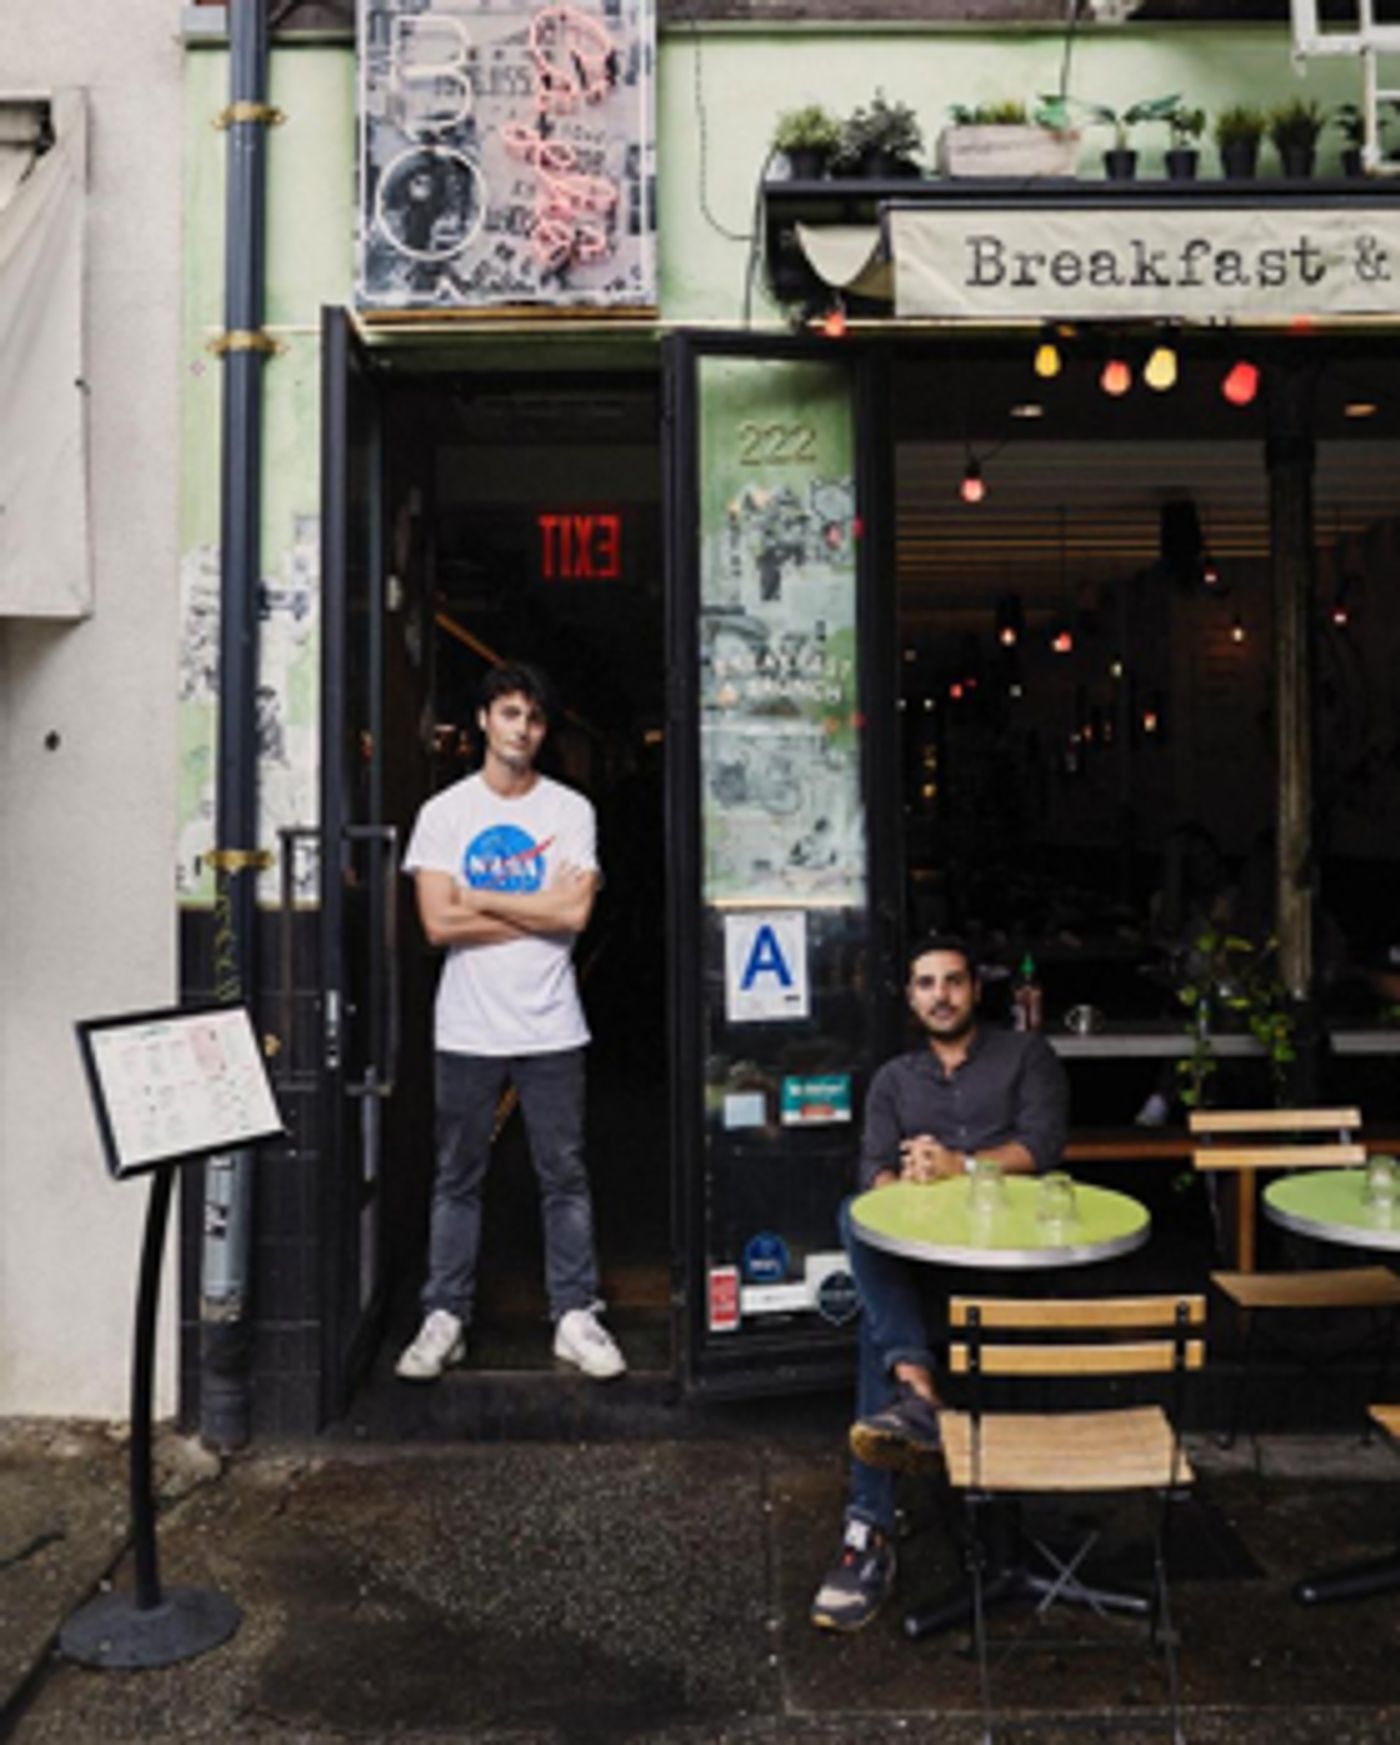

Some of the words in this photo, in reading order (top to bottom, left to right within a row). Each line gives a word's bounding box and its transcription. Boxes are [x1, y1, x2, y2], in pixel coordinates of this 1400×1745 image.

[964, 235, 1327, 288] Breakfast
[1354, 235, 1392, 282] &
[738, 419, 817, 467] 222
[470, 854, 538, 884] NASA
[740, 924, 793, 990] A
